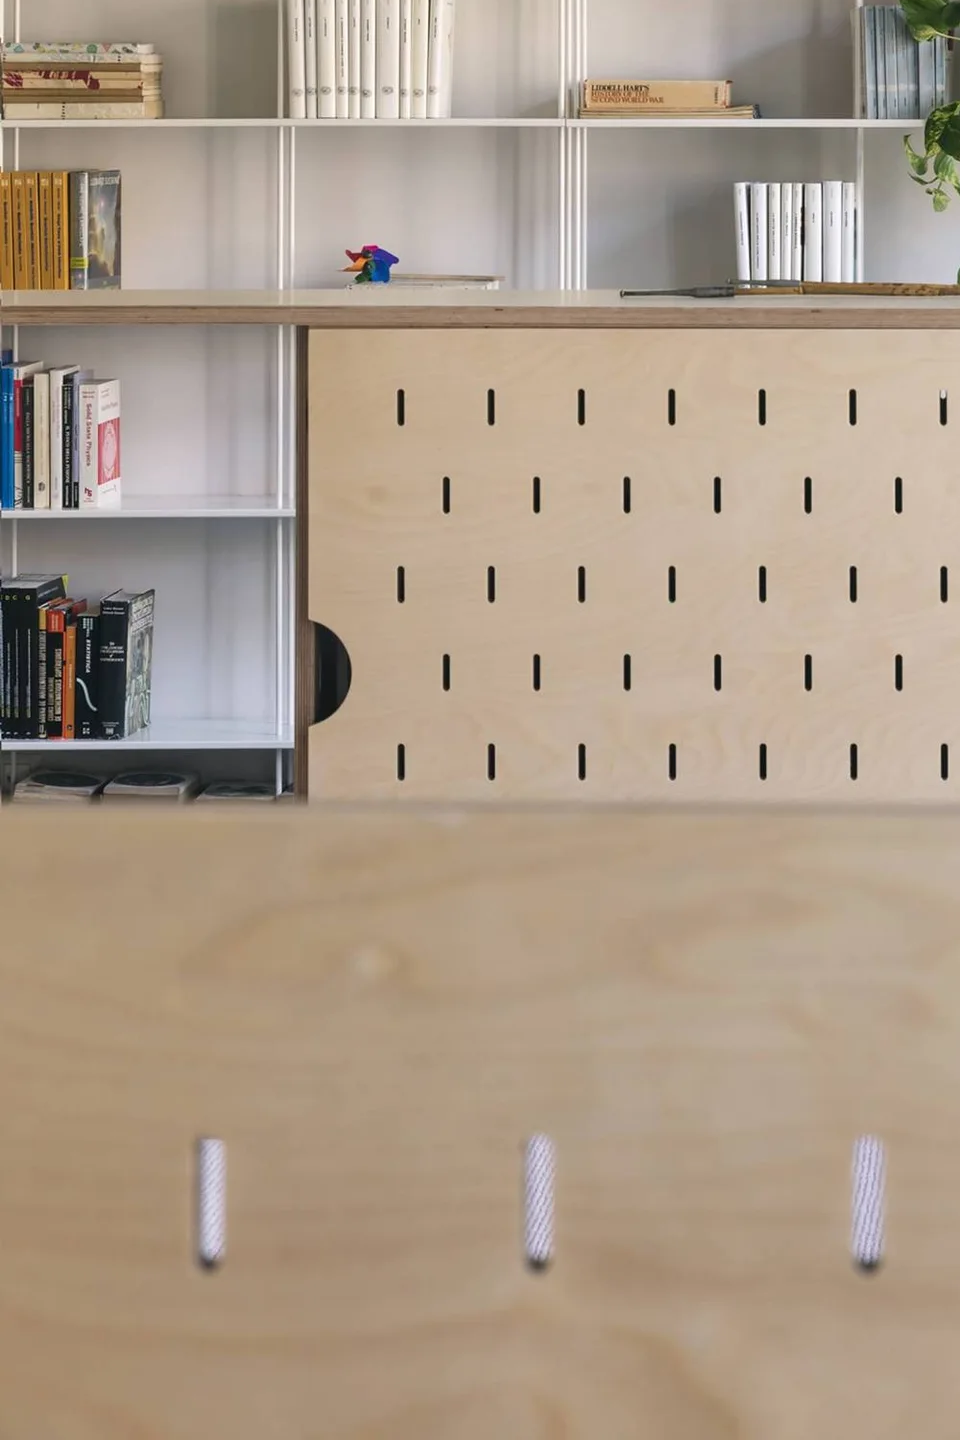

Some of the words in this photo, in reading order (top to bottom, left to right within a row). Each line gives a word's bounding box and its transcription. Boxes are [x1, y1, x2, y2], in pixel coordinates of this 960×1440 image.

[85, 403, 93, 421] Solid
[85, 421, 93, 440] State
[85, 441, 93, 467] Physics
